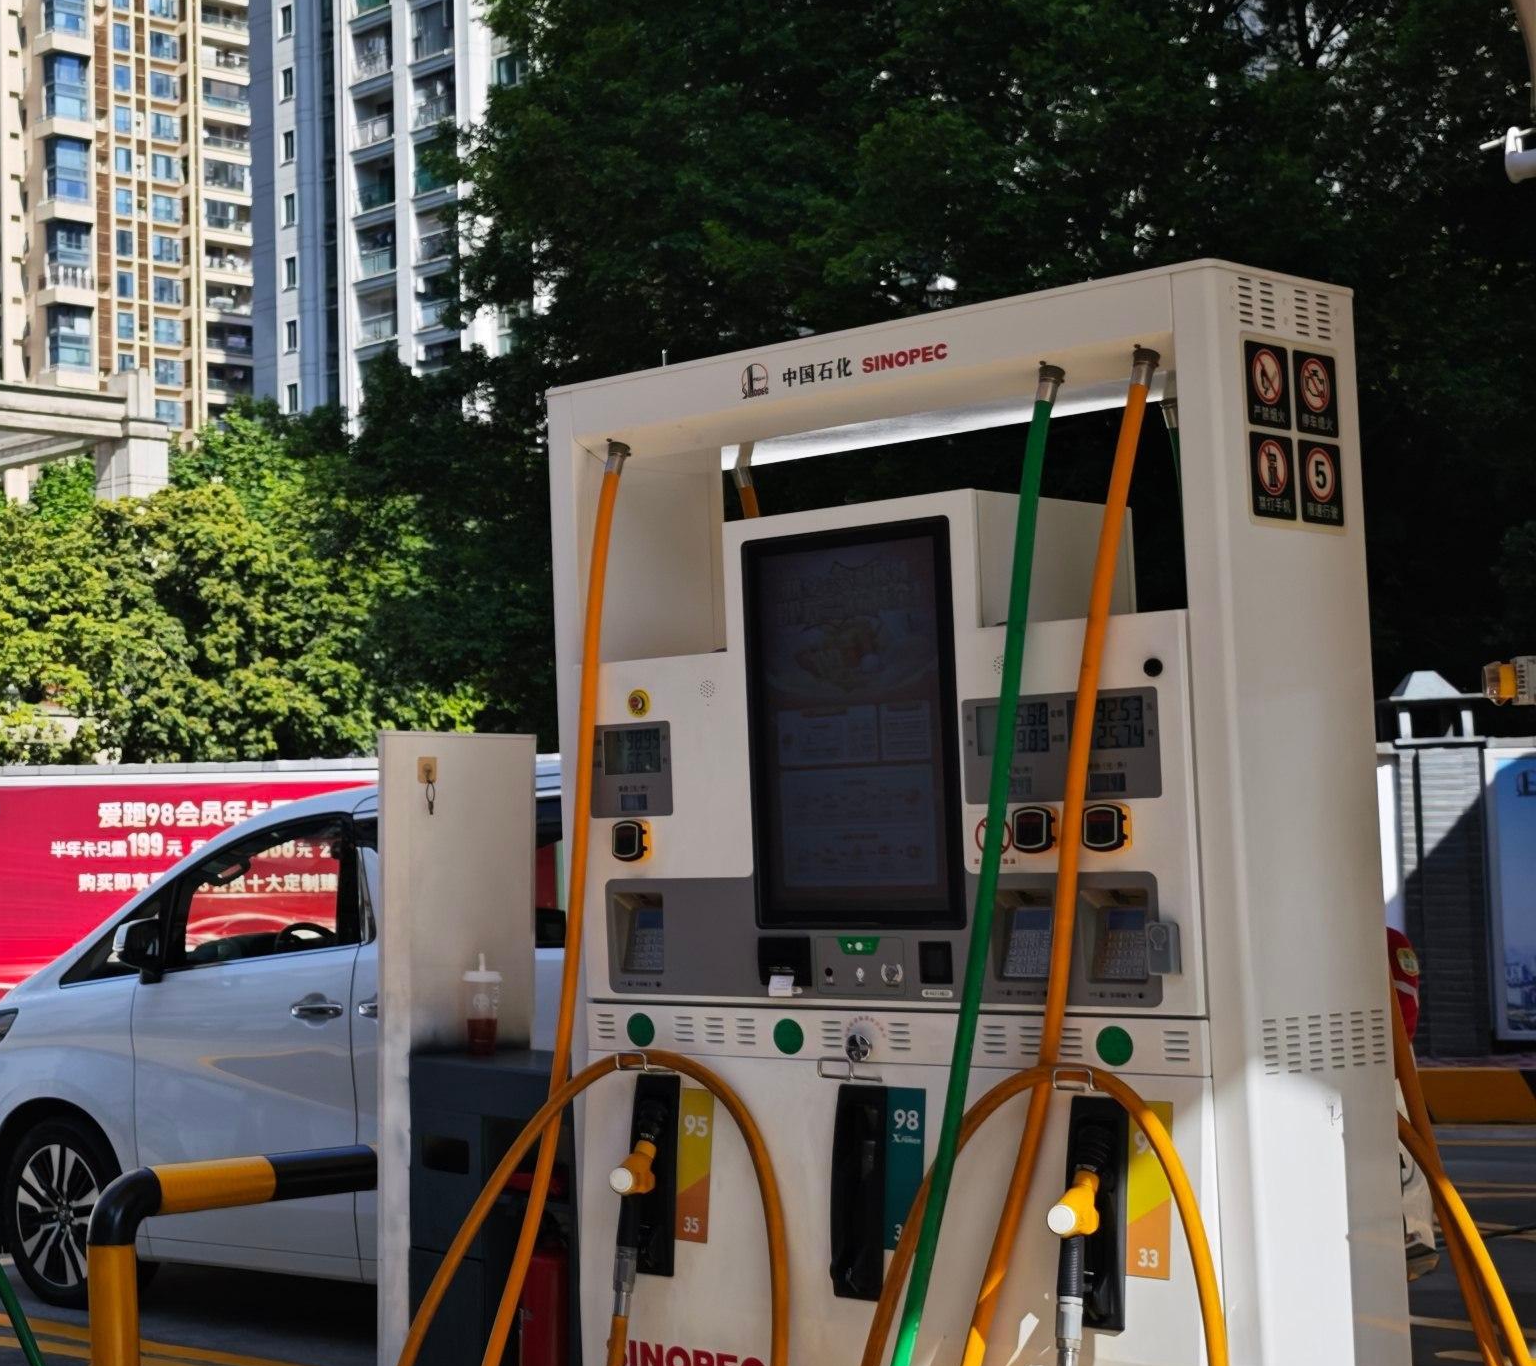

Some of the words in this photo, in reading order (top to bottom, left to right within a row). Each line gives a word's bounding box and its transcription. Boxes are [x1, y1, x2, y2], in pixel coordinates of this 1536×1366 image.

[782, 357, 853, 388] 中国石化
[862, 343, 948, 374] SINOPEC
[1314, 461, 1328, 490] 5
[684, 1114, 709, 1137] 95
[893, 1108, 919, 1131] 98
[683, 1217, 700, 1234] 35
[1137, 1248, 1159, 1268] 33
